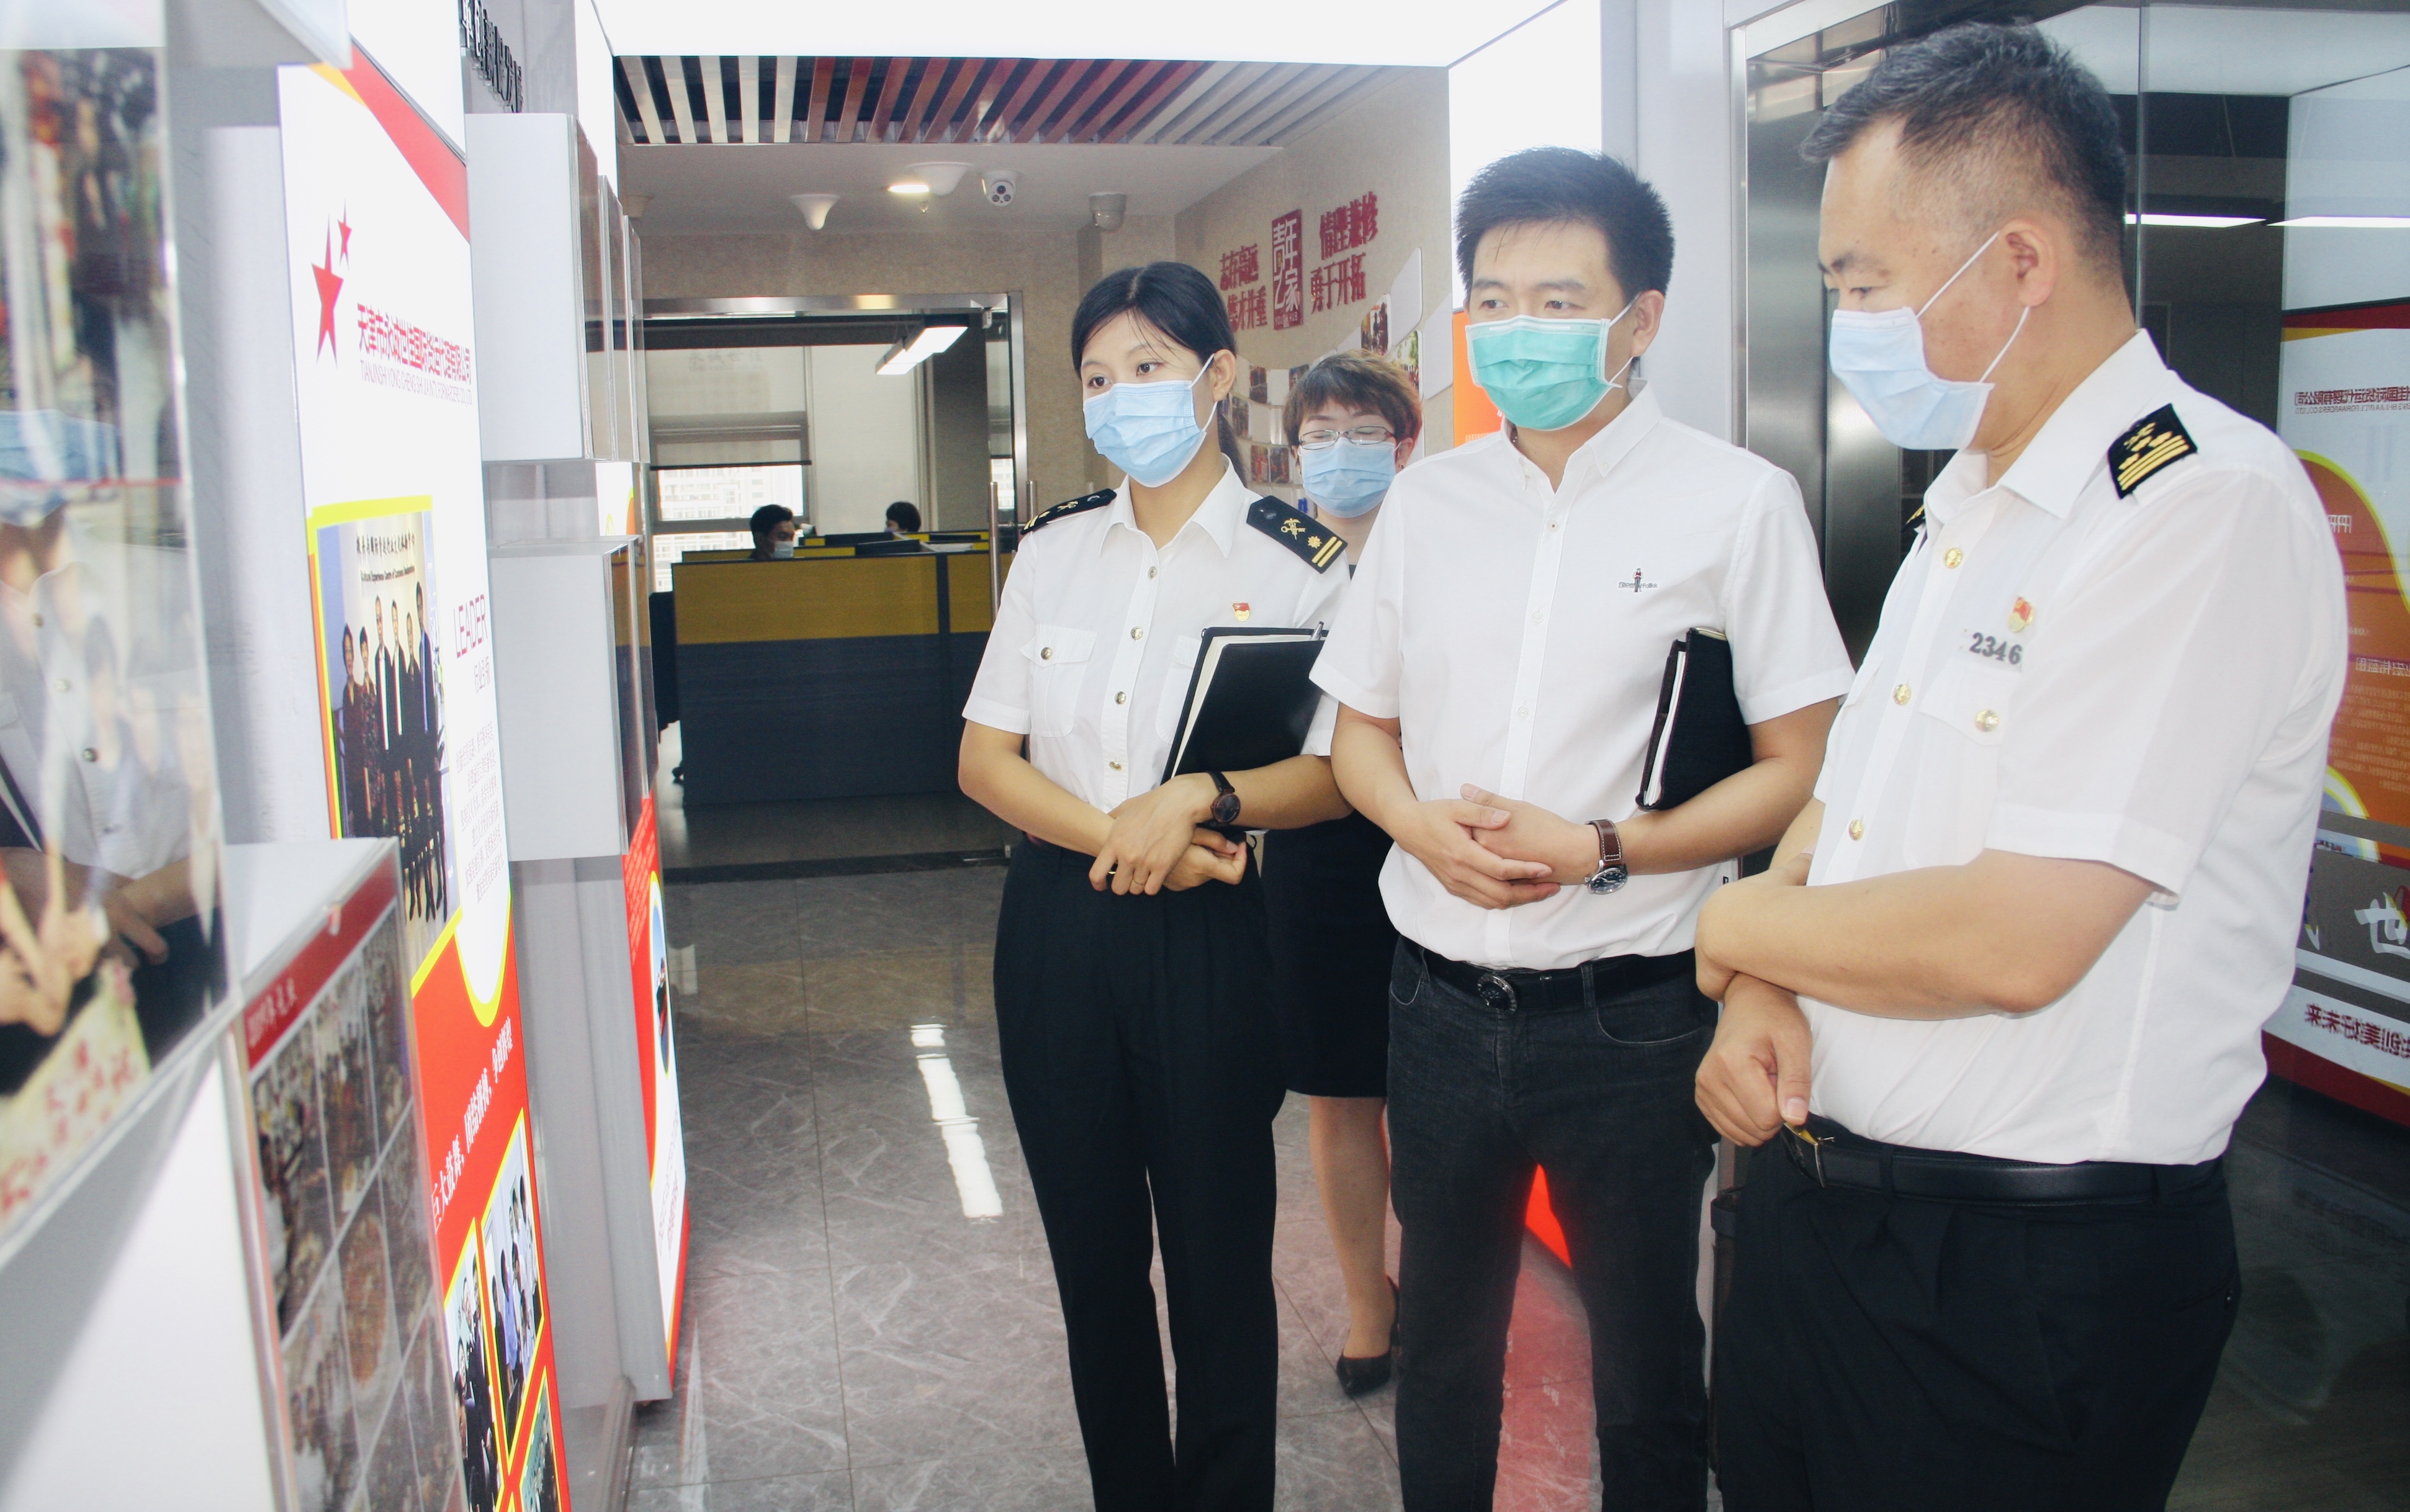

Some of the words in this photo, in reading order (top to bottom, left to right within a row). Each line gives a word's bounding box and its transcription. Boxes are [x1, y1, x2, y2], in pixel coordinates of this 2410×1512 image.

[1311, 252, 1367, 314] 勇于开拓
[453, 594, 488, 659] LEADER
[1969, 631, 2023, 665] 2346
